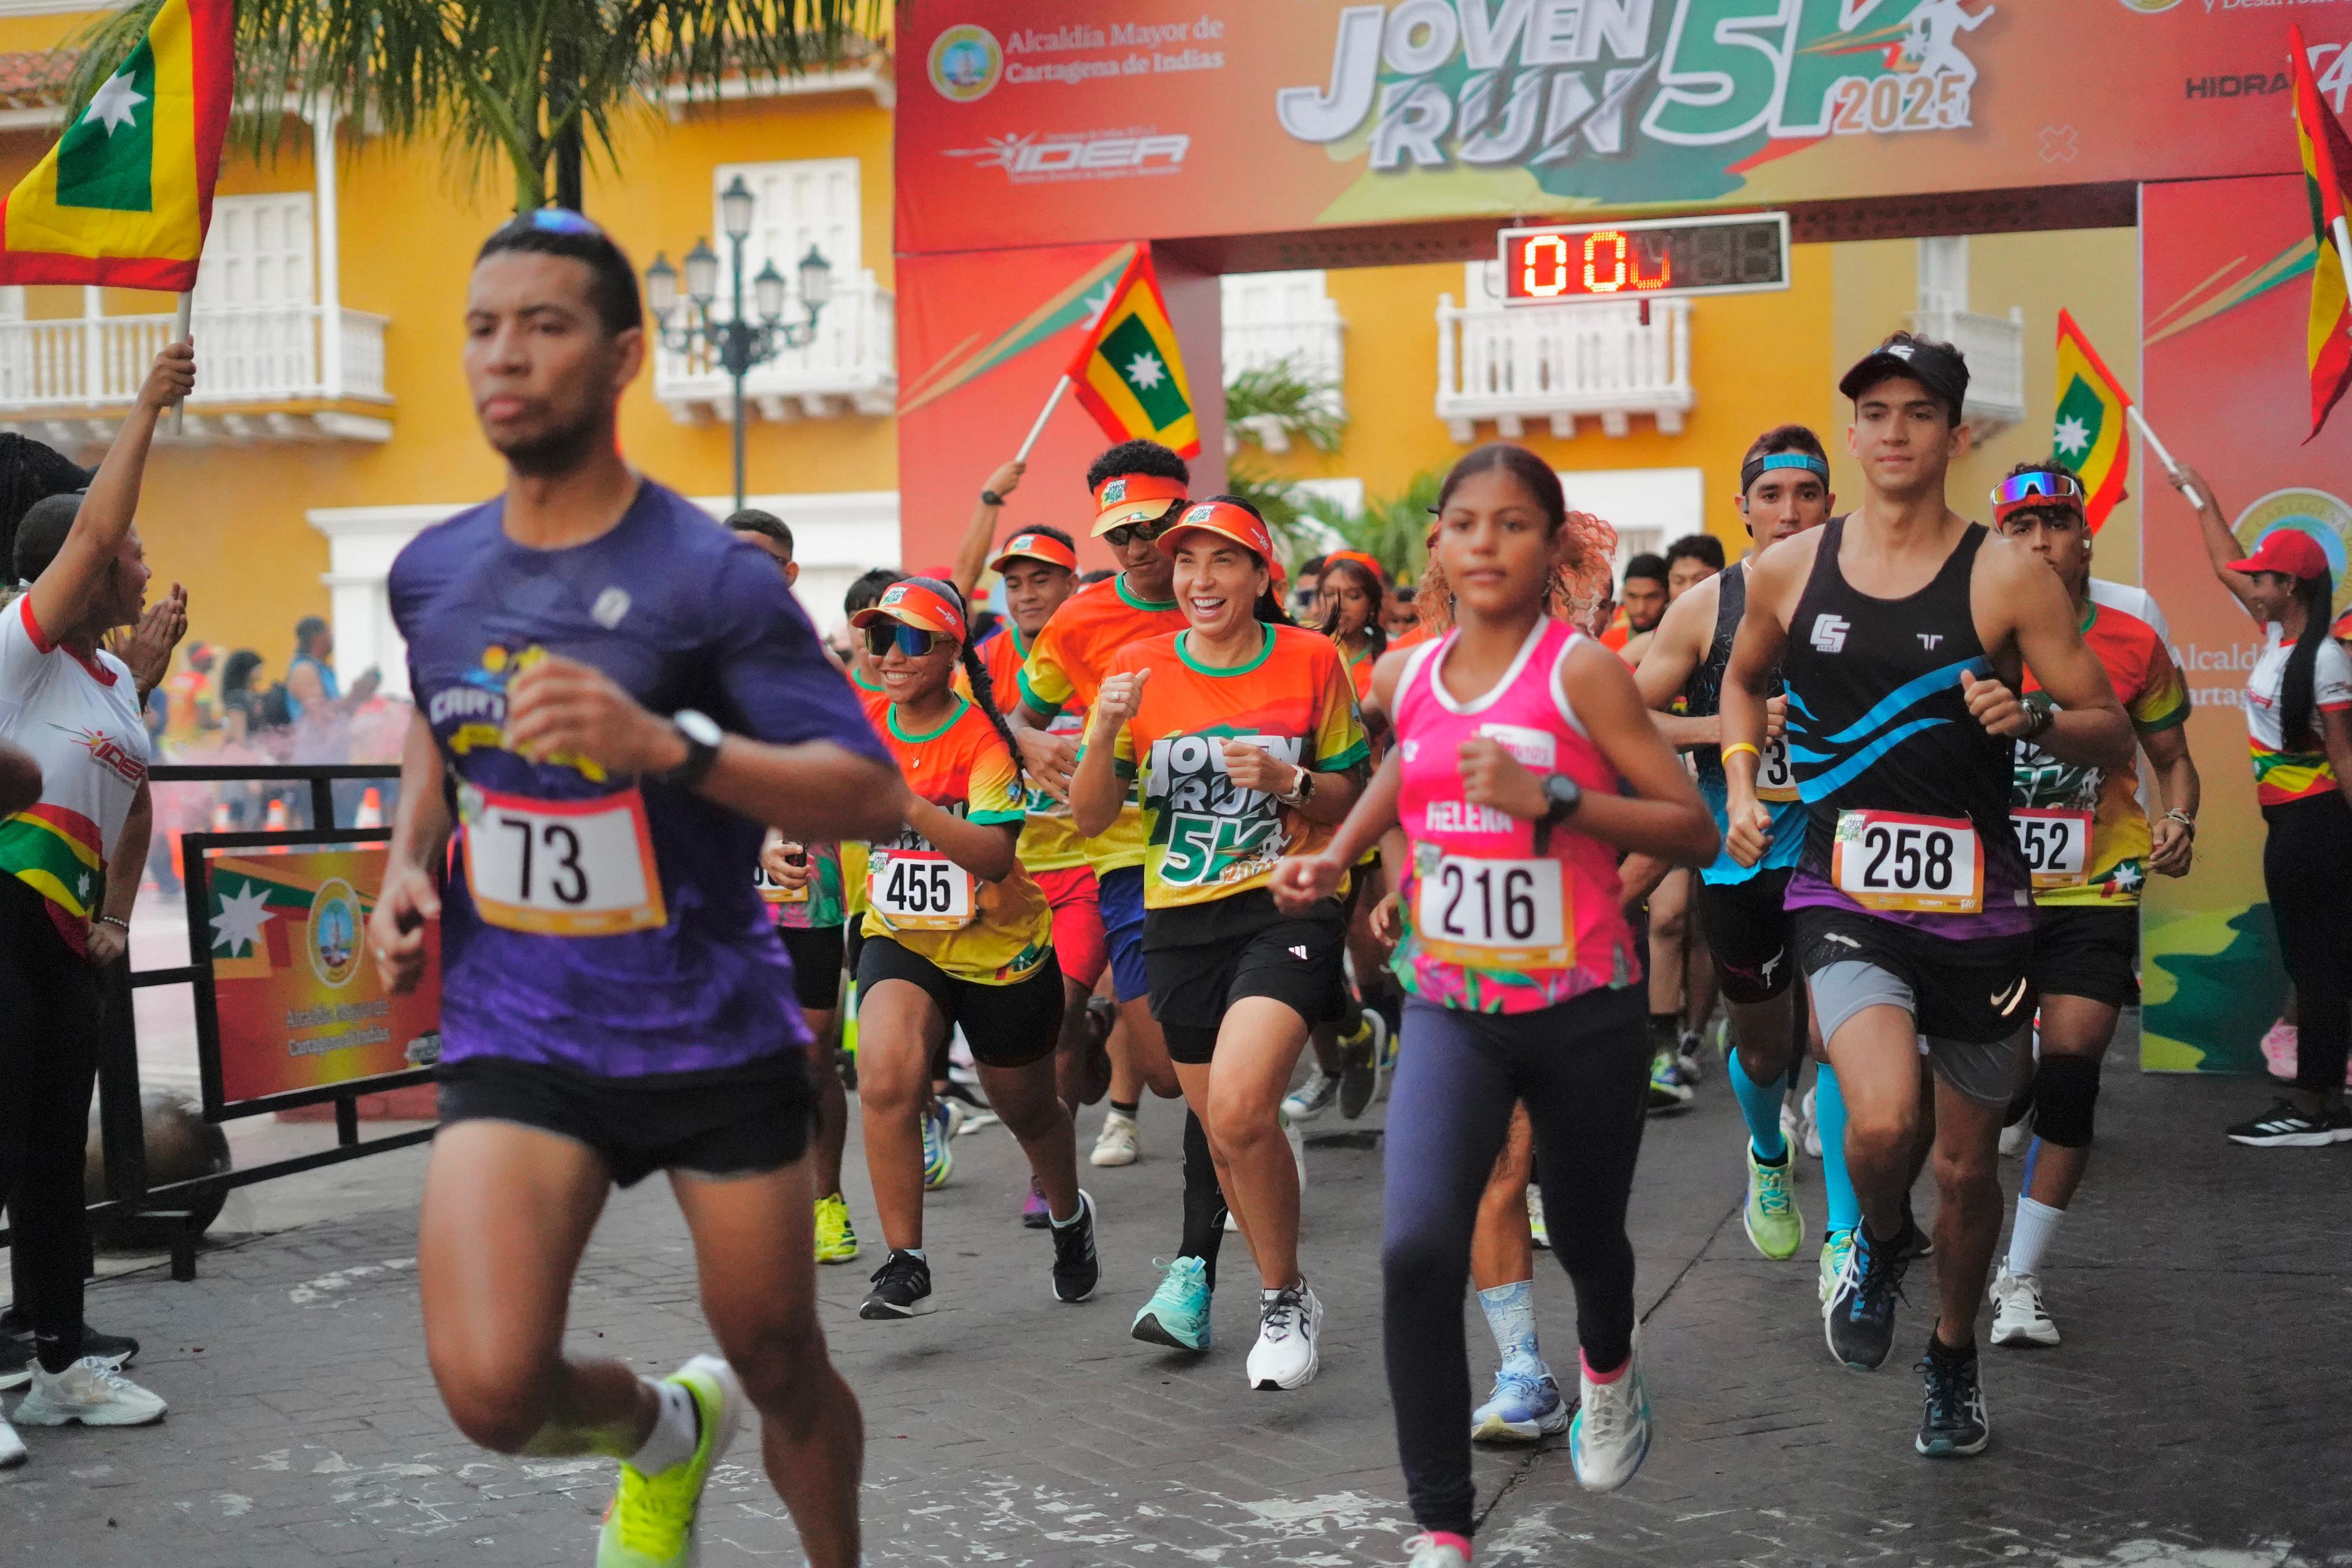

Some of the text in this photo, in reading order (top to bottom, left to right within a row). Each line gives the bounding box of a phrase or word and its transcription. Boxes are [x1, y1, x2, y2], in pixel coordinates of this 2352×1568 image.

[1005, 14, 1225, 54] Alcaldía Mayor de
[1005, 49, 1225, 85] Cartagena de Indias
[1276, 0, 1657, 142] JOVEN
[2185, 72, 2291, 99] HIDRA
[1367, 54, 1660, 170] RUN
[1833, 73, 1969, 133] 2025
[1426, 800, 1514, 834] HELENA
[501, 817, 589, 906] 73
[1158, 812, 1282, 888] 5K
[1864, 826, 1953, 890] 258
[886, 863, 951, 912] 455
[1442, 864, 1534, 939] 216
